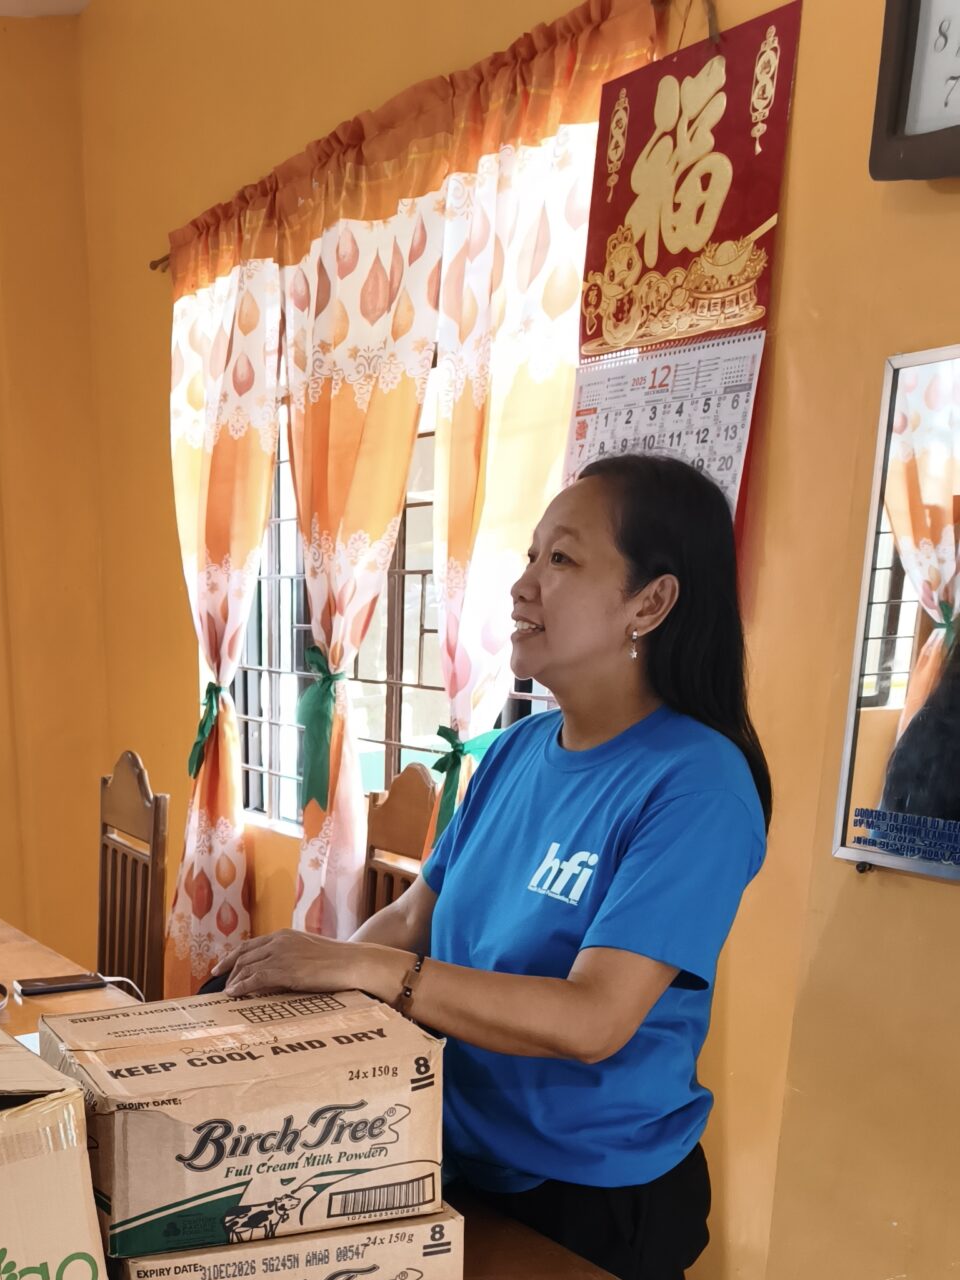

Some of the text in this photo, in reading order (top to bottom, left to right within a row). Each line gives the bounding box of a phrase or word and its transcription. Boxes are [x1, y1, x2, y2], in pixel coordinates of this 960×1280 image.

[934, 18, 951, 52] 8
[944, 75, 960, 108] 7
[625, 55, 733, 268] 福
[631, 375, 647, 387] 2025
[648, 364, 671, 390] 12
[604, 394, 740, 427] 1 2 3 4 5 6
[576, 425, 737, 458] 7 8 9 10 11 12 13
[717, 456, 733, 471] 20
[529, 842, 599, 900] hfi
[70, 1014, 120, 1024] LAYERS
[107, 1027, 388, 1080] KEEP COOL AND DRY
[414, 1056, 430, 1075] 8
[152, 1098, 182, 1108] DATE:
[176, 1099, 386, 1172] Birch Tree
[224, 1148, 385, 1179] Full Cream Milk Powder
[430, 1224, 445, 1242] 8
[137, 1266, 176, 1279] EXPIRY
[177, 1263, 202, 1276] DATE:
[201, 1260, 256, 1280] 31DEC2026
